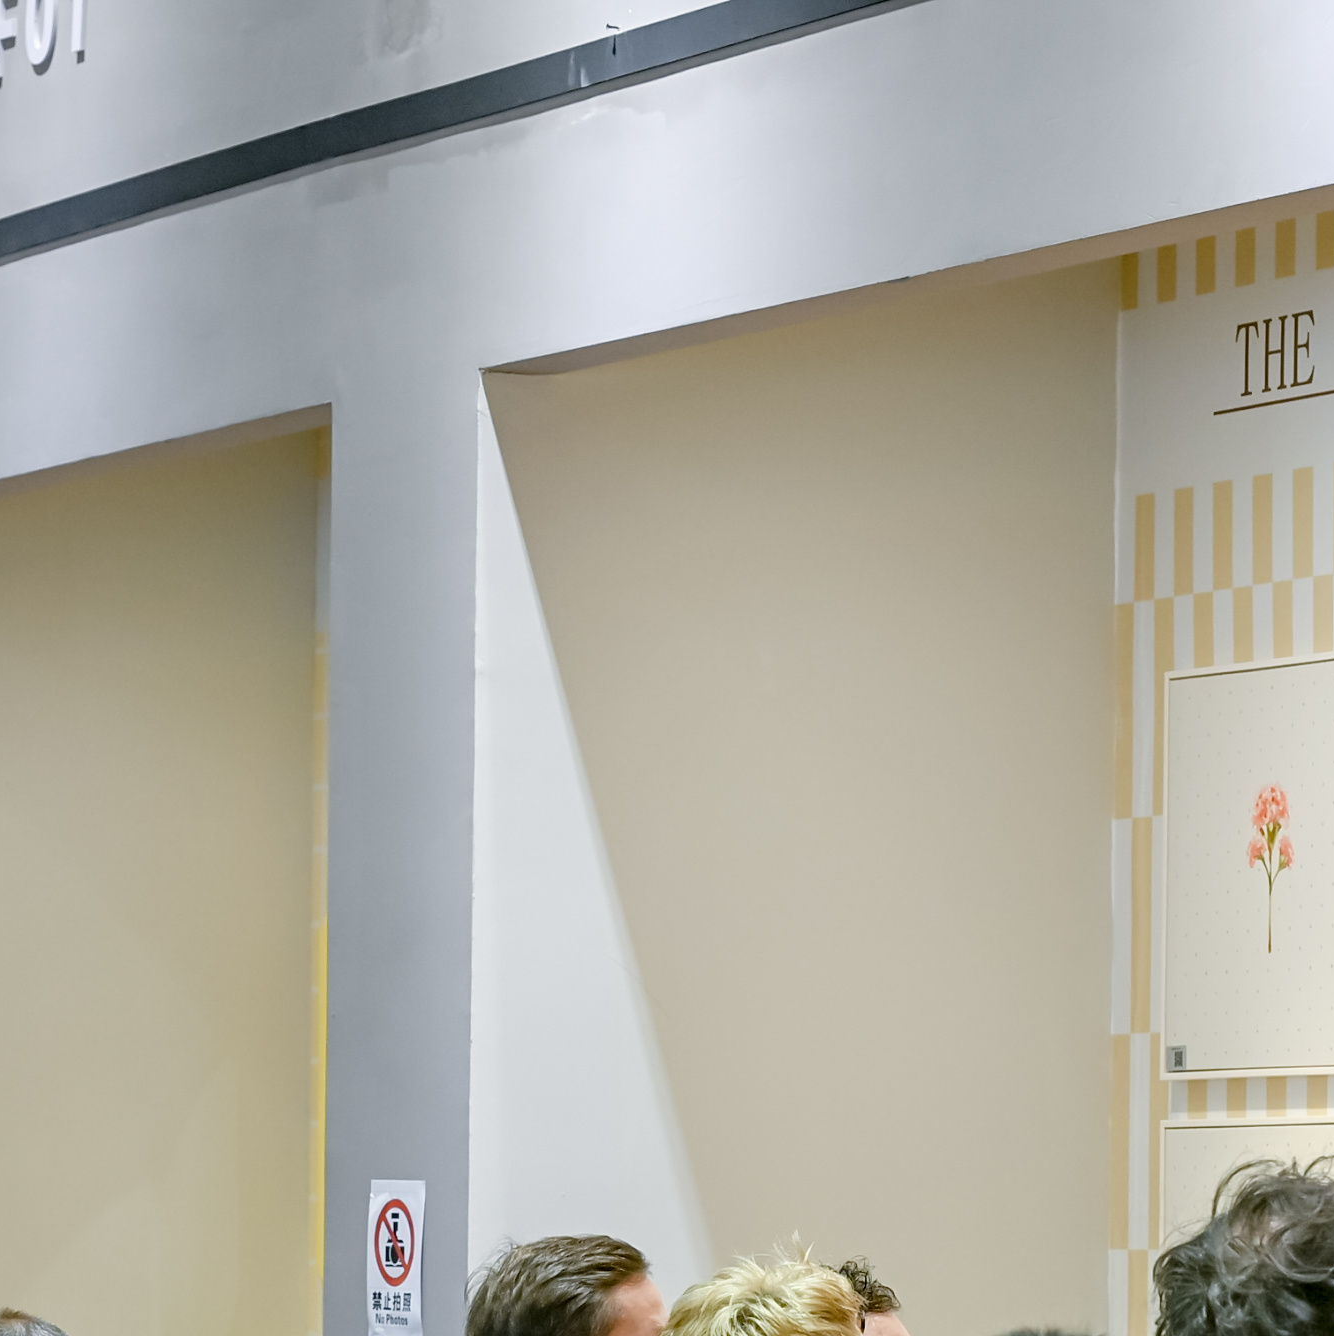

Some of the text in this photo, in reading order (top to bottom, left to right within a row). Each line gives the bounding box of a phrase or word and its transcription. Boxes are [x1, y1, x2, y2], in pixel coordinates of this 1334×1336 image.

[1235, 310, 1315, 397] THE
[372, 1291, 412, 1312] 禁止拍照
[375, 1313, 408, 1326] No Photos
